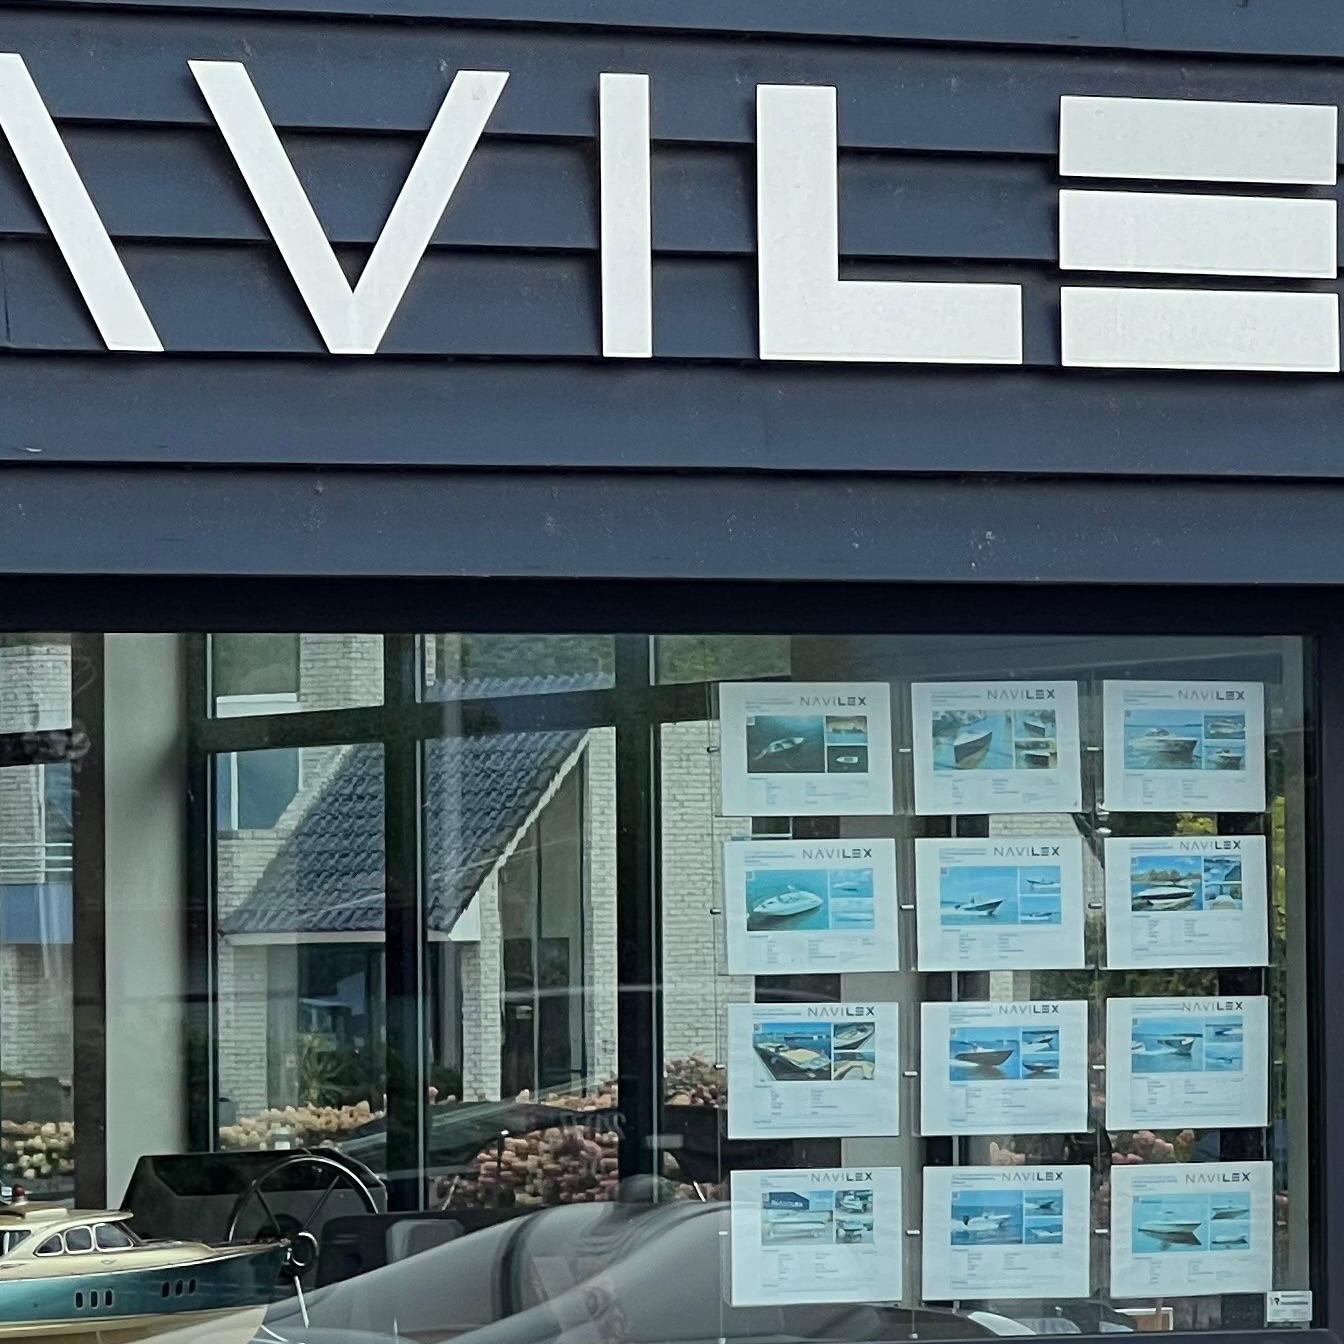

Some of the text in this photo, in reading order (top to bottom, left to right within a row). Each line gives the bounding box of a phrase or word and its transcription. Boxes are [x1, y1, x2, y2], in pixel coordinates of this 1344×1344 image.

[987, 689, 1056, 700] NAVILEX
[1178, 690, 1246, 700] NAVILEX
[800, 696, 866, 706] NAVILEX
[1179, 840, 1242, 850] NAVILEX
[802, 848, 873, 859] NAVILEX
[994, 846, 1060, 856] NAVILEX
[998, 1004, 1060, 1014] NAVILEX
[1182, 1001, 1244, 1011] NAVILEX
[807, 1006, 874, 1017] NAVILEX
[811, 1172, 872, 1182] NAVILEX
[1002, 1171, 1064, 1182] NAVILEX
[1186, 1172, 1250, 1183] NAVILEX
